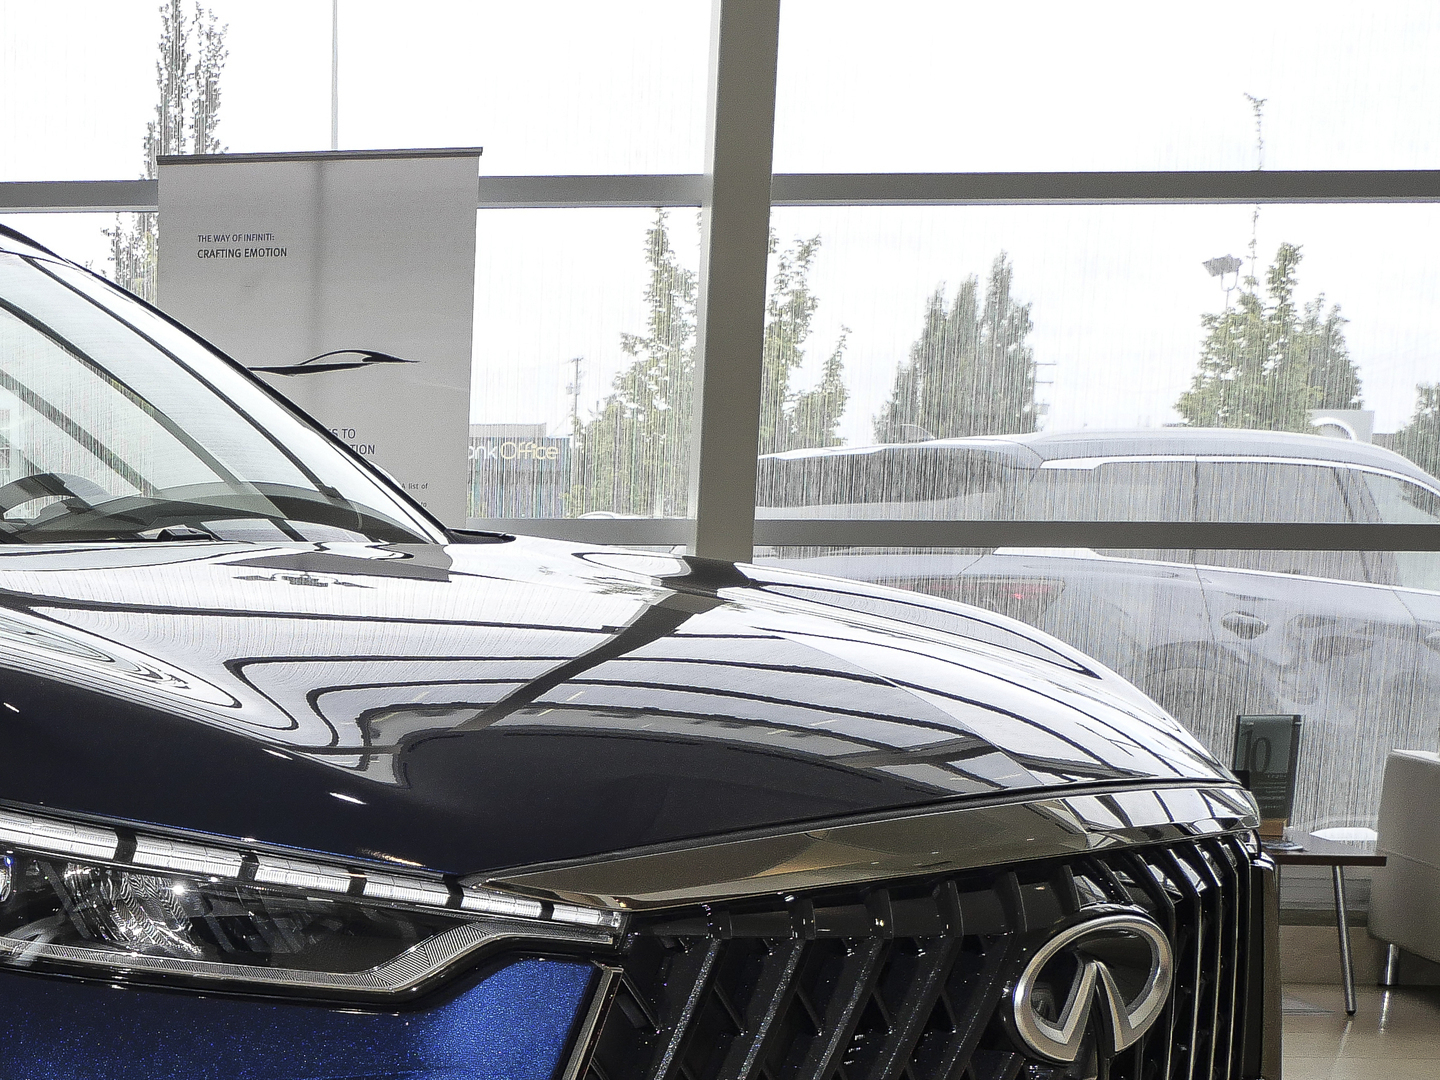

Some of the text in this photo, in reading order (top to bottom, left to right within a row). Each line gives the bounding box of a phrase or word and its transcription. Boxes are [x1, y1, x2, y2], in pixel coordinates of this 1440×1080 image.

[198, 232, 275, 243] THE WAY OF INFINITI:
[197, 247, 287, 259] CRAFTING EMOTION
[341, 428, 356, 439] TO
[500, 441, 559, 460] Office
[409, 482, 419, 490] list
[420, 482, 428, 490] of
